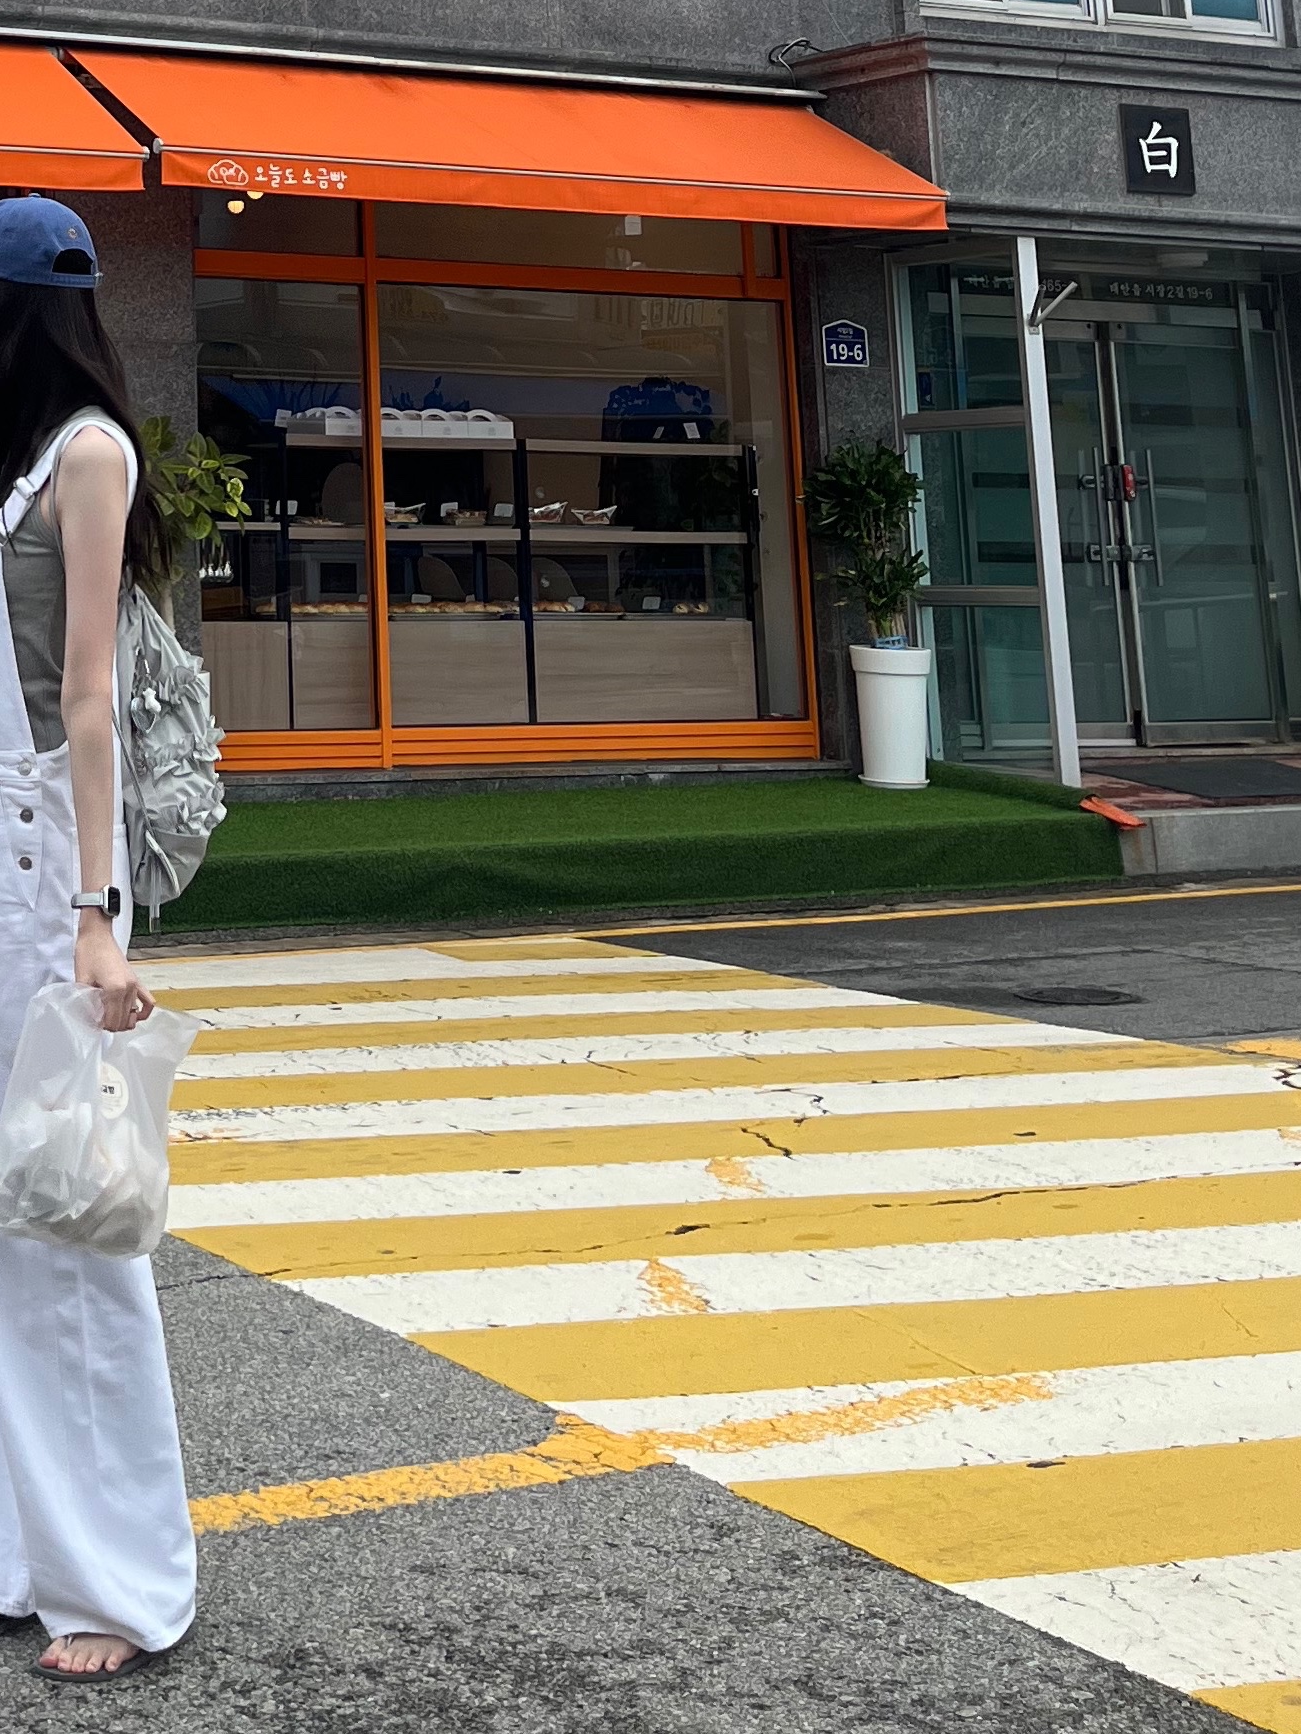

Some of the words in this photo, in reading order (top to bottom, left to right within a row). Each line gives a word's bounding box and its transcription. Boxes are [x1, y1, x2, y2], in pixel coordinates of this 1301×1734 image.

[1139, 121, 1179, 179] 白
[254, 163, 298, 189] 오늘도
[301, 167, 348, 190] 소금빵
[1186, 286, 1213, 301] 19-6
[829, 343, 863, 361] 19-6
